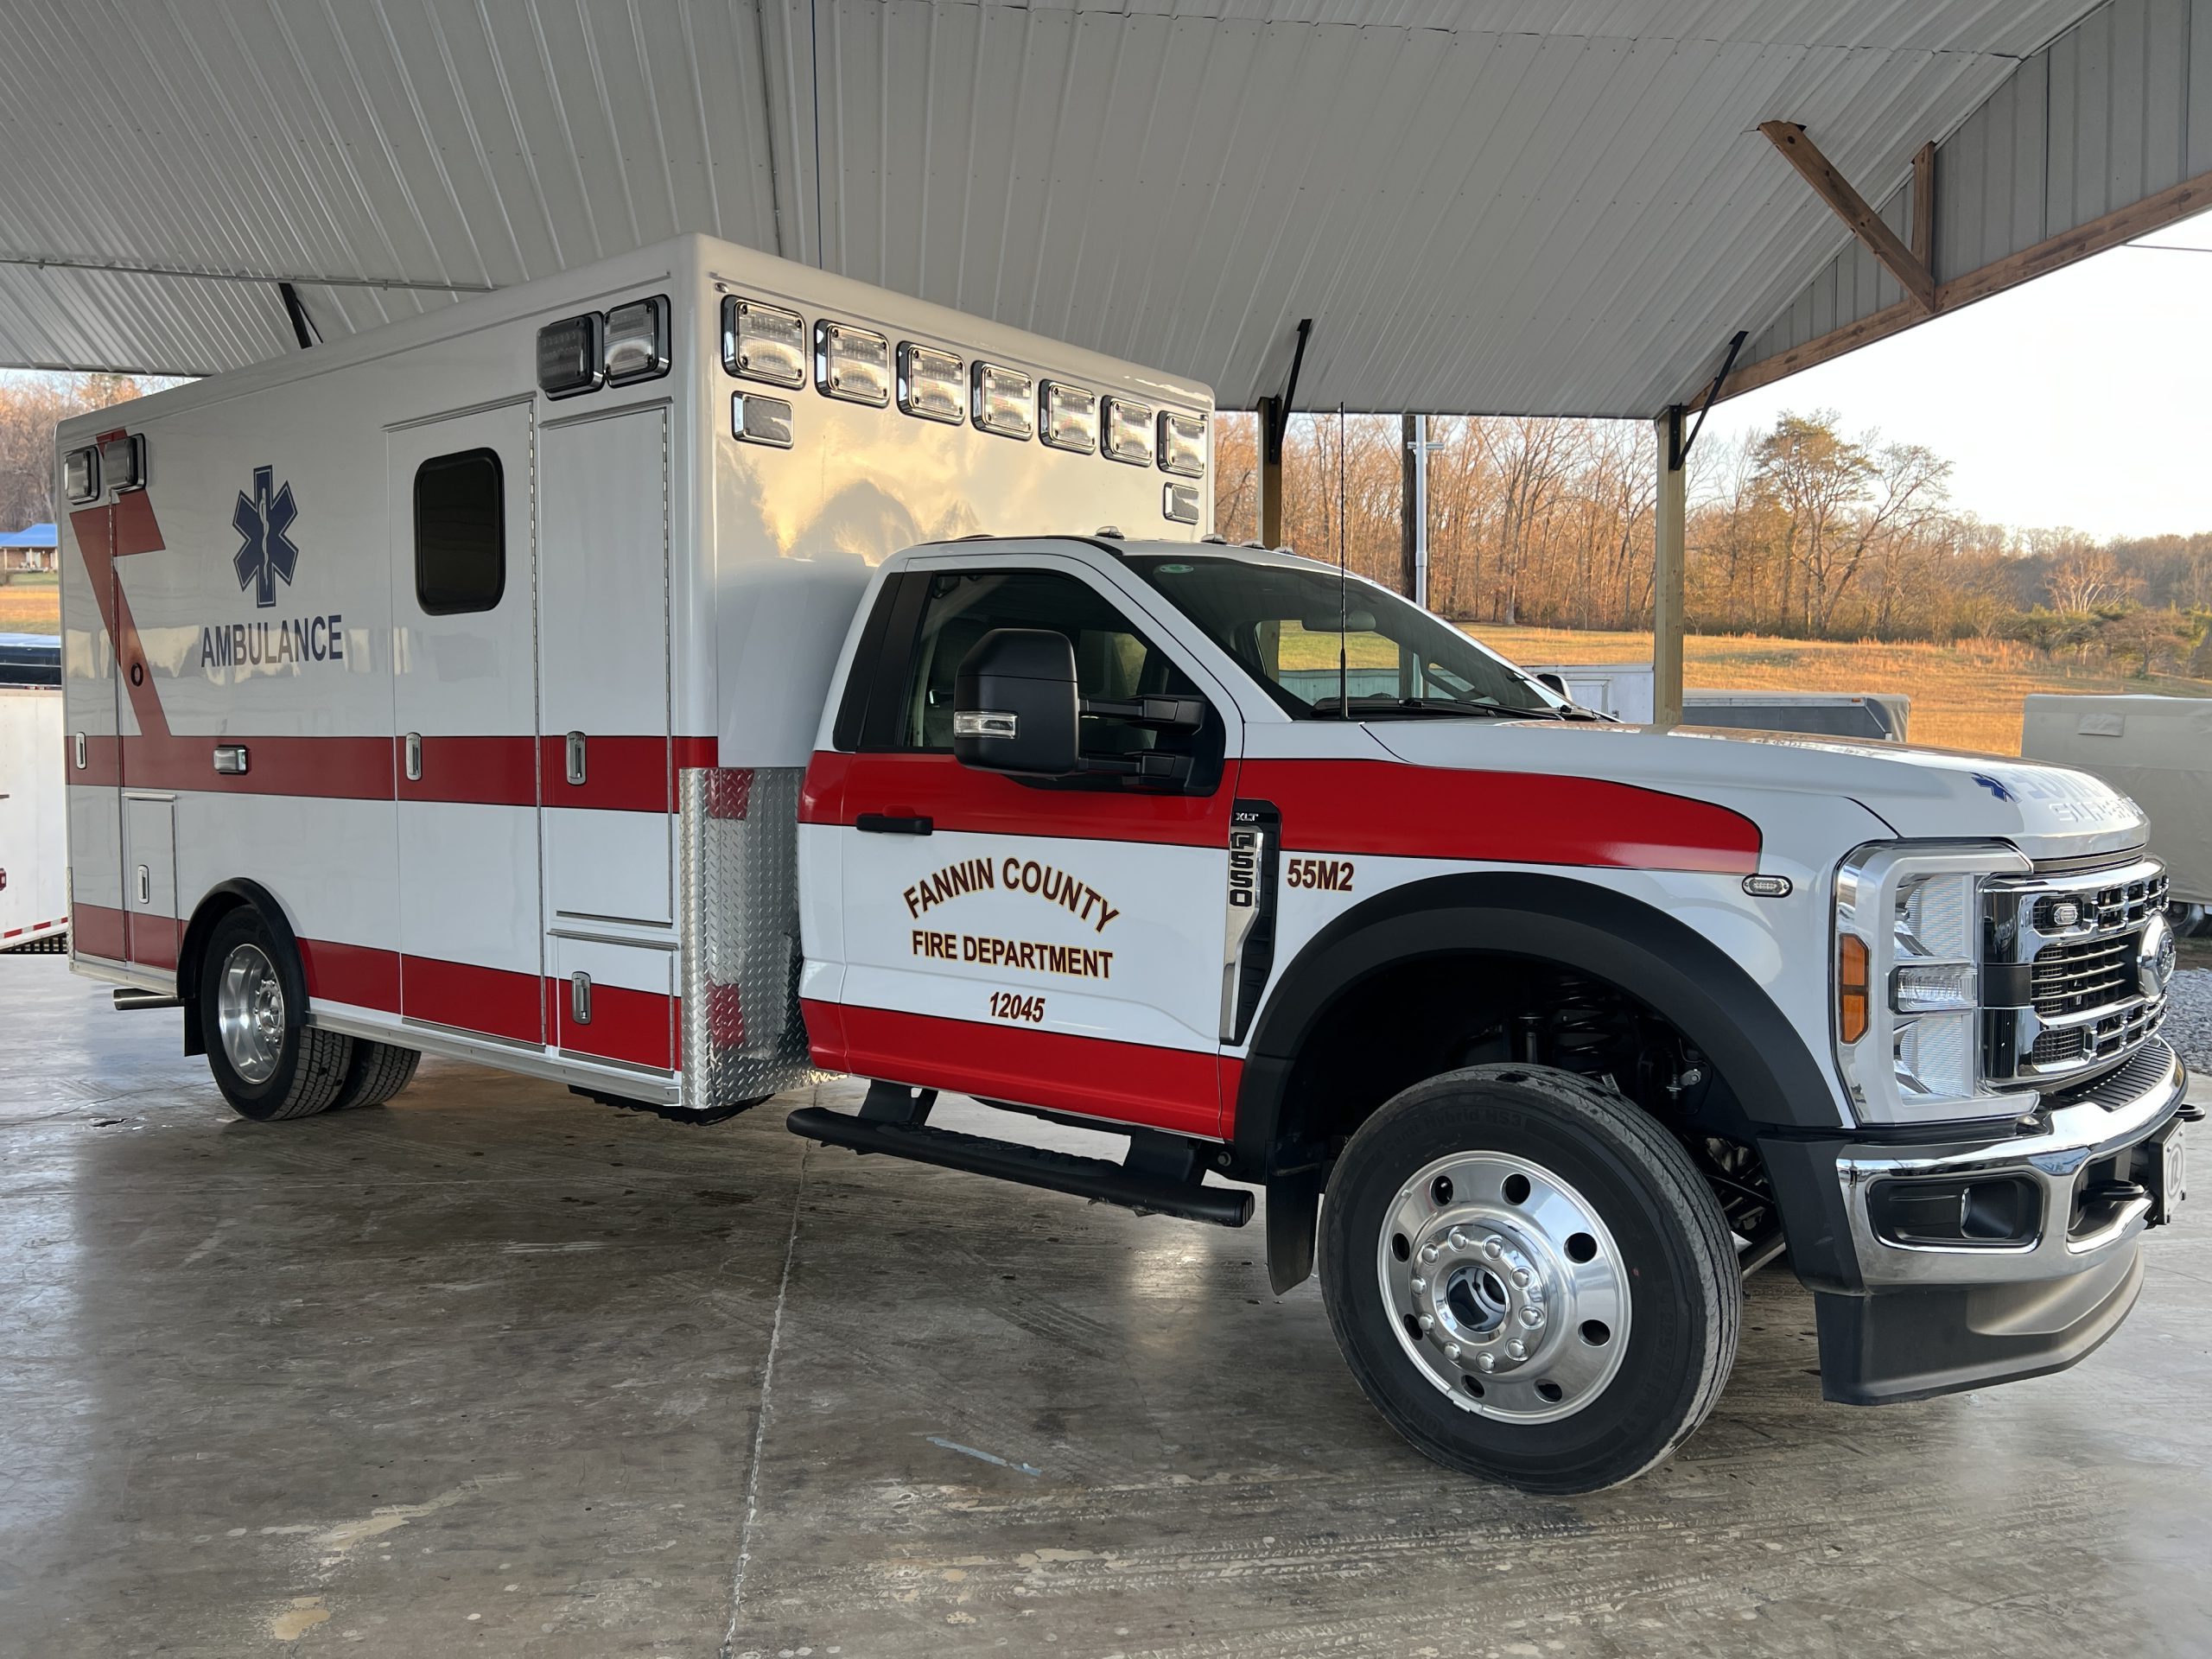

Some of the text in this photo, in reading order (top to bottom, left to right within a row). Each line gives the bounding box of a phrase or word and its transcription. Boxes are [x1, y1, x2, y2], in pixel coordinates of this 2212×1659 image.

[200, 613, 344, 669] AMBULANCE
[1235, 812, 1259, 822] XLT
[1230, 831, 1255, 907] F550
[1286, 858, 1356, 893] 55M2
[902, 856, 1121, 934] FANNIN COUNTY
[911, 929, 1115, 980] FIRE DEPARTMENT
[988, 990, 1047, 1024] 12045
